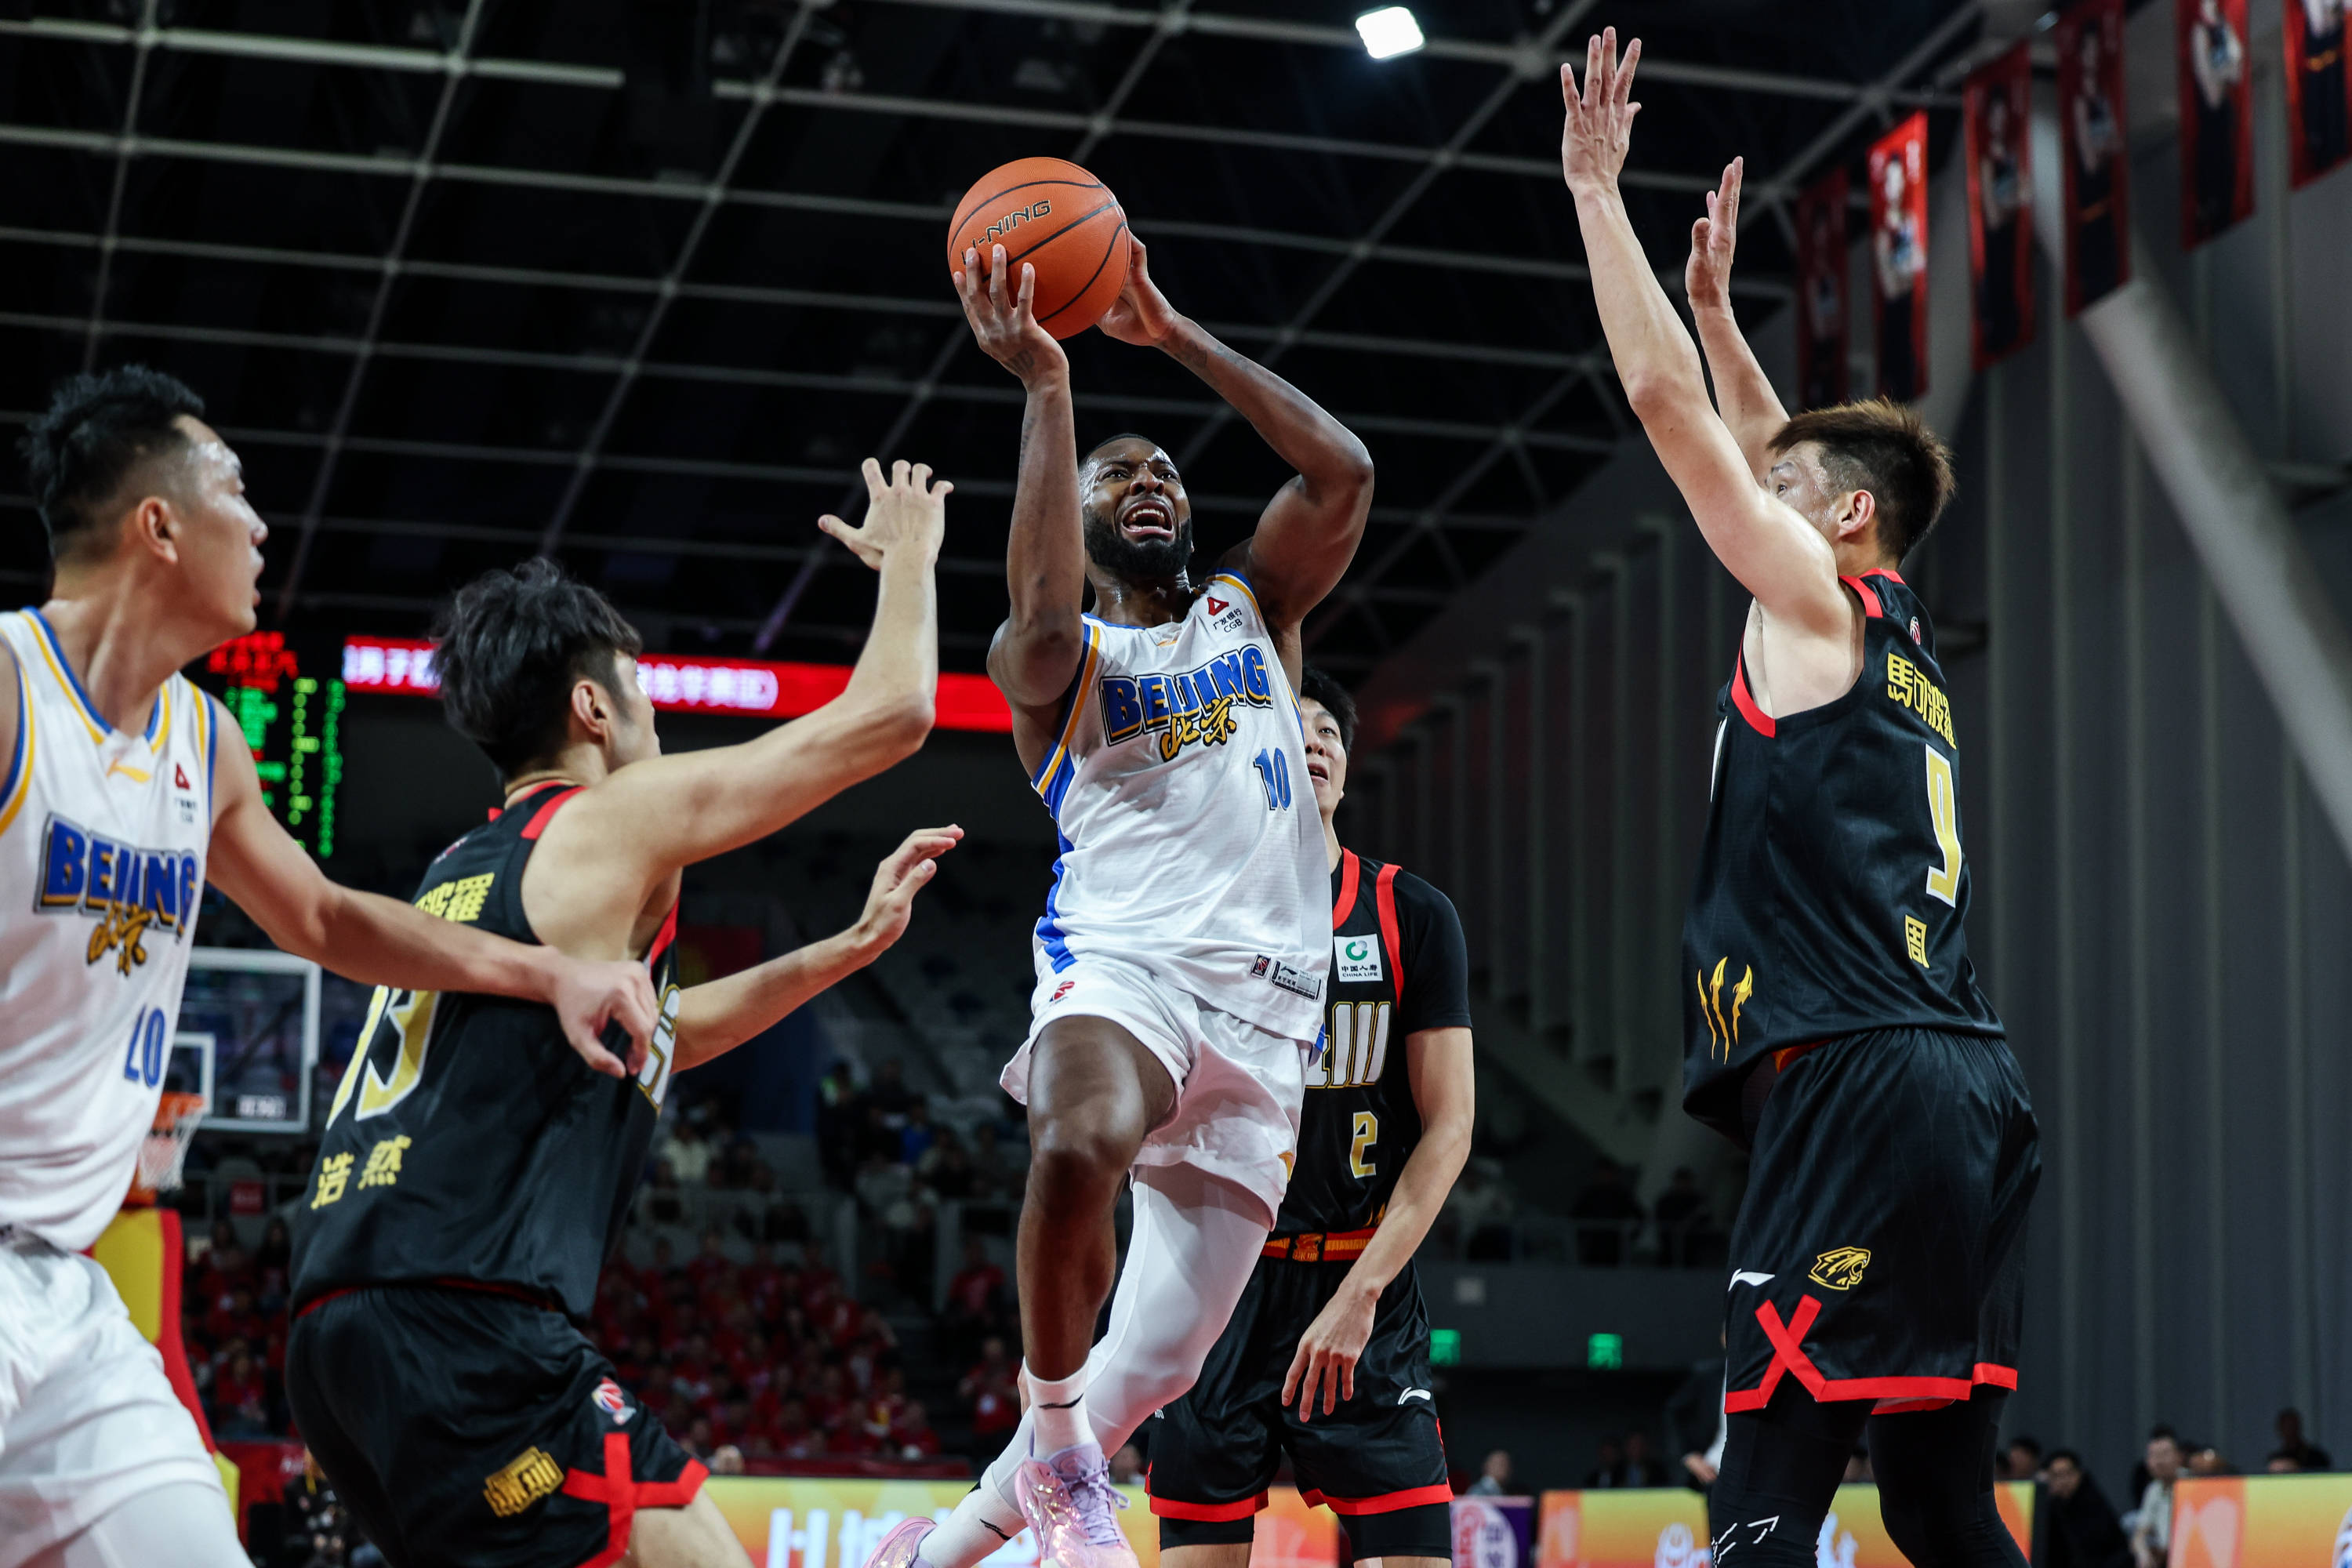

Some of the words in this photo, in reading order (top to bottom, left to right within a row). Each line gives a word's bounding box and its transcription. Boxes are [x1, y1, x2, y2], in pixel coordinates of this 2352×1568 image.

[1224, 619, 1243, 633] CGB
[1099, 644, 1273, 746] BEIJING
[1160, 696, 1237, 762] 北京
[1254, 746, 1292, 811] 10
[1926, 743, 1962, 909] 9
[34, 812, 198, 941] BEIING
[1905, 914, 1929, 969] 周
[326, 985, 439, 1131] 13
[1350, 1111, 1378, 1178] 2
